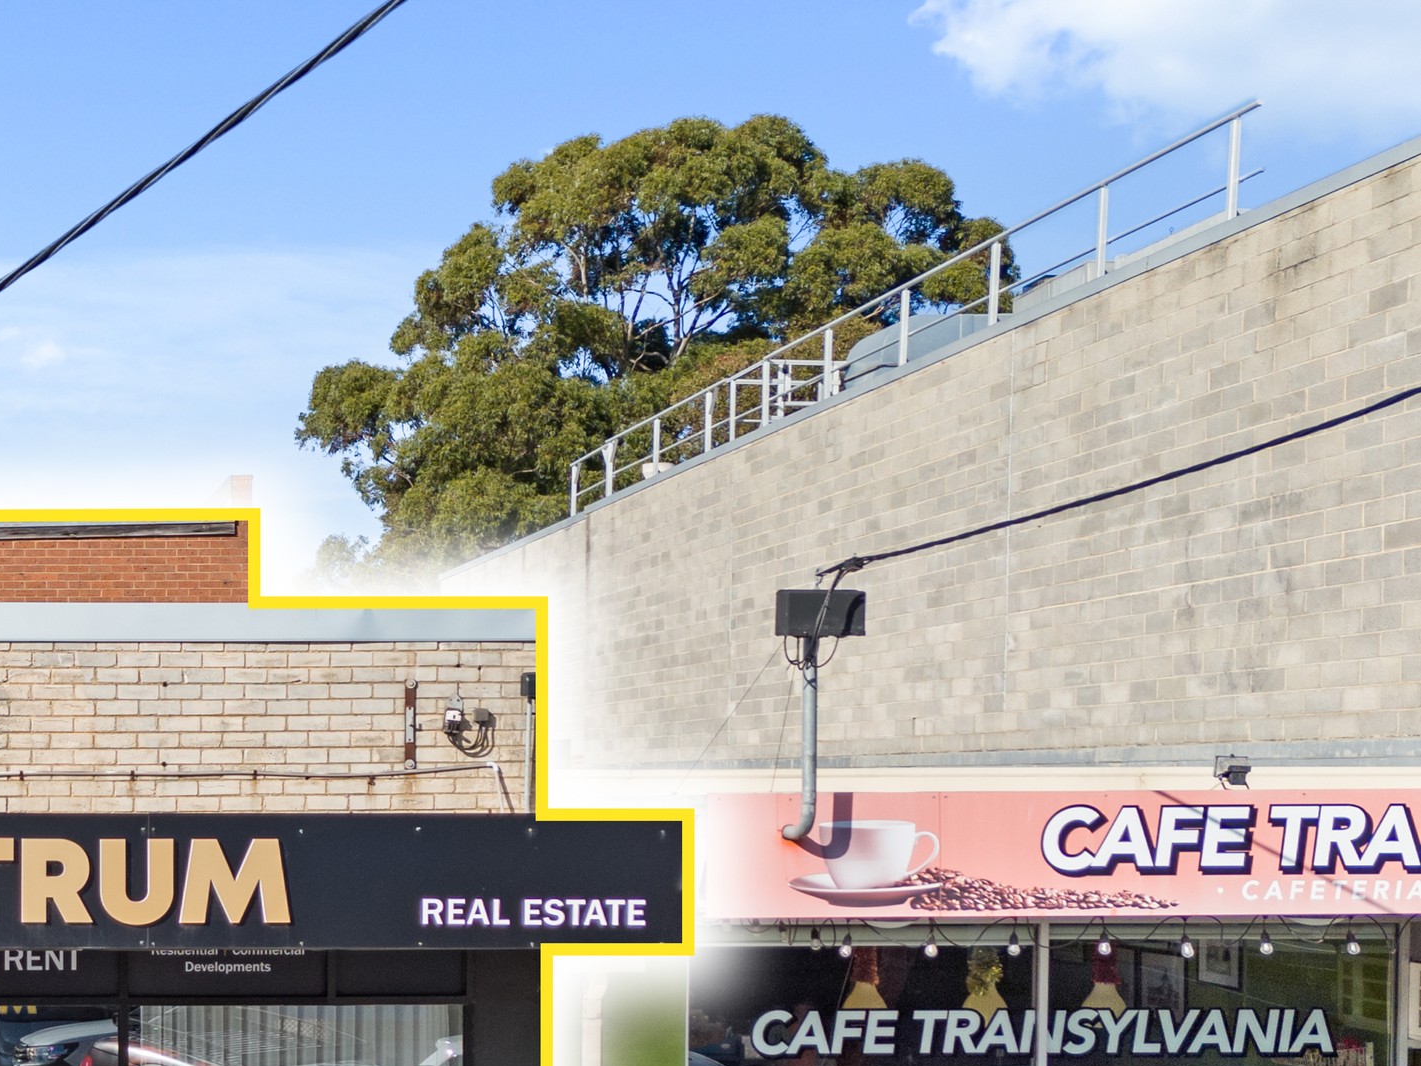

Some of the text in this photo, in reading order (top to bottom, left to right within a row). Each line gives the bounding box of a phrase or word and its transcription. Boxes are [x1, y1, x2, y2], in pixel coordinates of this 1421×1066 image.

[1041, 803, 1421, 877] CAFE TRA
[421, 898, 646, 926] REAL ESTATE
[4, 950, 82, 971] RENT
[185, 961, 271, 974] Developments
[750, 1009, 1337, 1056] CAFE TRANSYLVANIA
